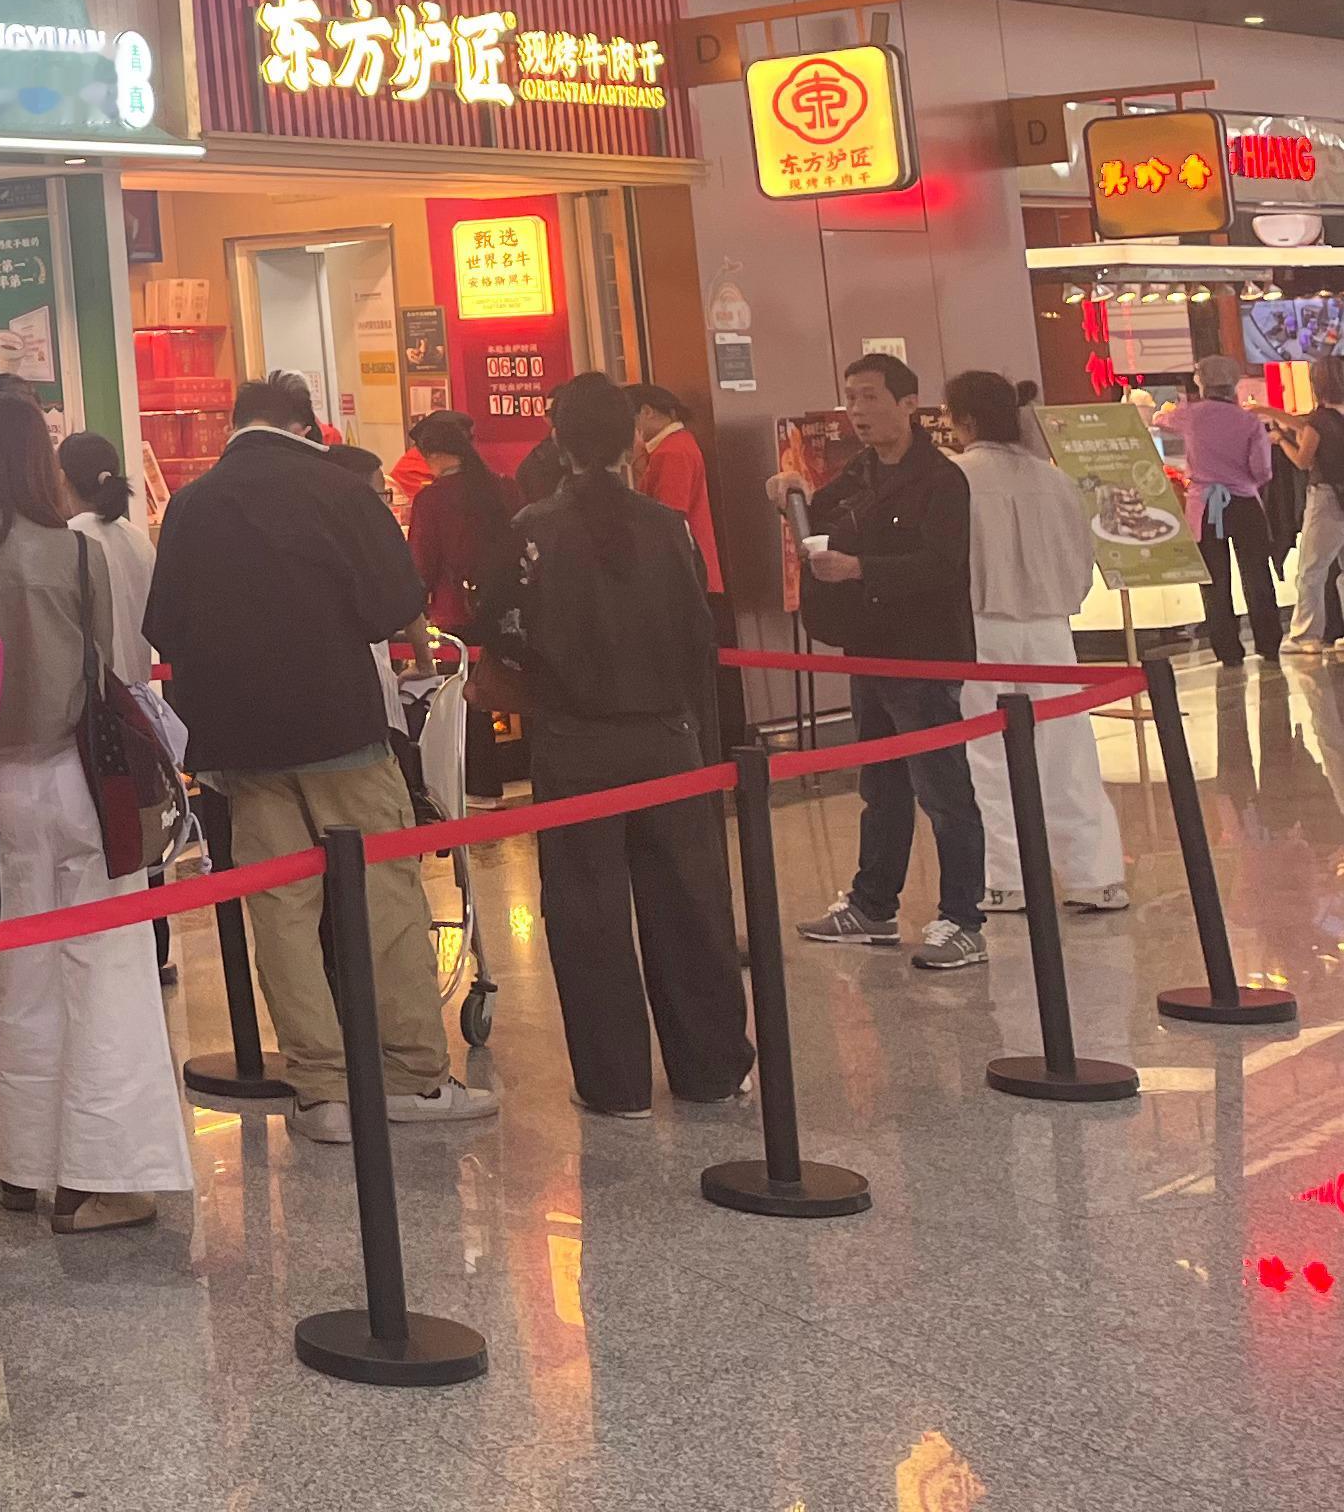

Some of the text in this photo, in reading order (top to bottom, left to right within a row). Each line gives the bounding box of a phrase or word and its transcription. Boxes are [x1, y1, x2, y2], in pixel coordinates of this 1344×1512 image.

[516, 30, 665, 84] 现烤牛肉干
[779, 146, 873, 175] 东方炉匠
[789, 173, 871, 190] 现烤牛肉干
[473, 227, 519, 250] 甄选
[466, 251, 531, 270] 世界名牛
[488, 357, 543, 377] 06:00
